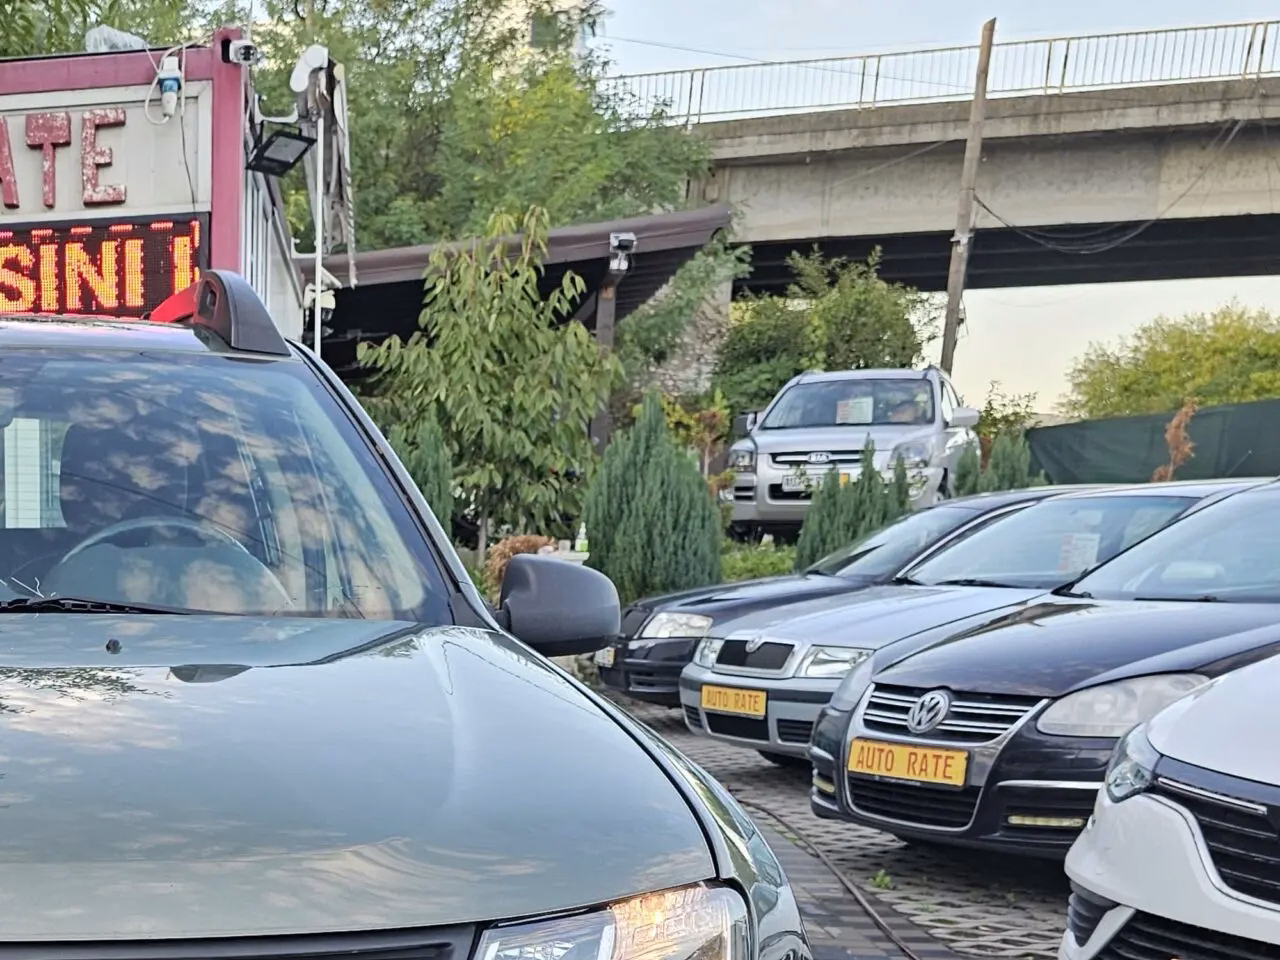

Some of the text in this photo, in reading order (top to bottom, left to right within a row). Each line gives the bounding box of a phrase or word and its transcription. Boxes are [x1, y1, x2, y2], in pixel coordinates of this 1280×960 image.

[706, 689, 760, 712] AUTO RATE
[856, 745, 955, 780] AUTO RATE
